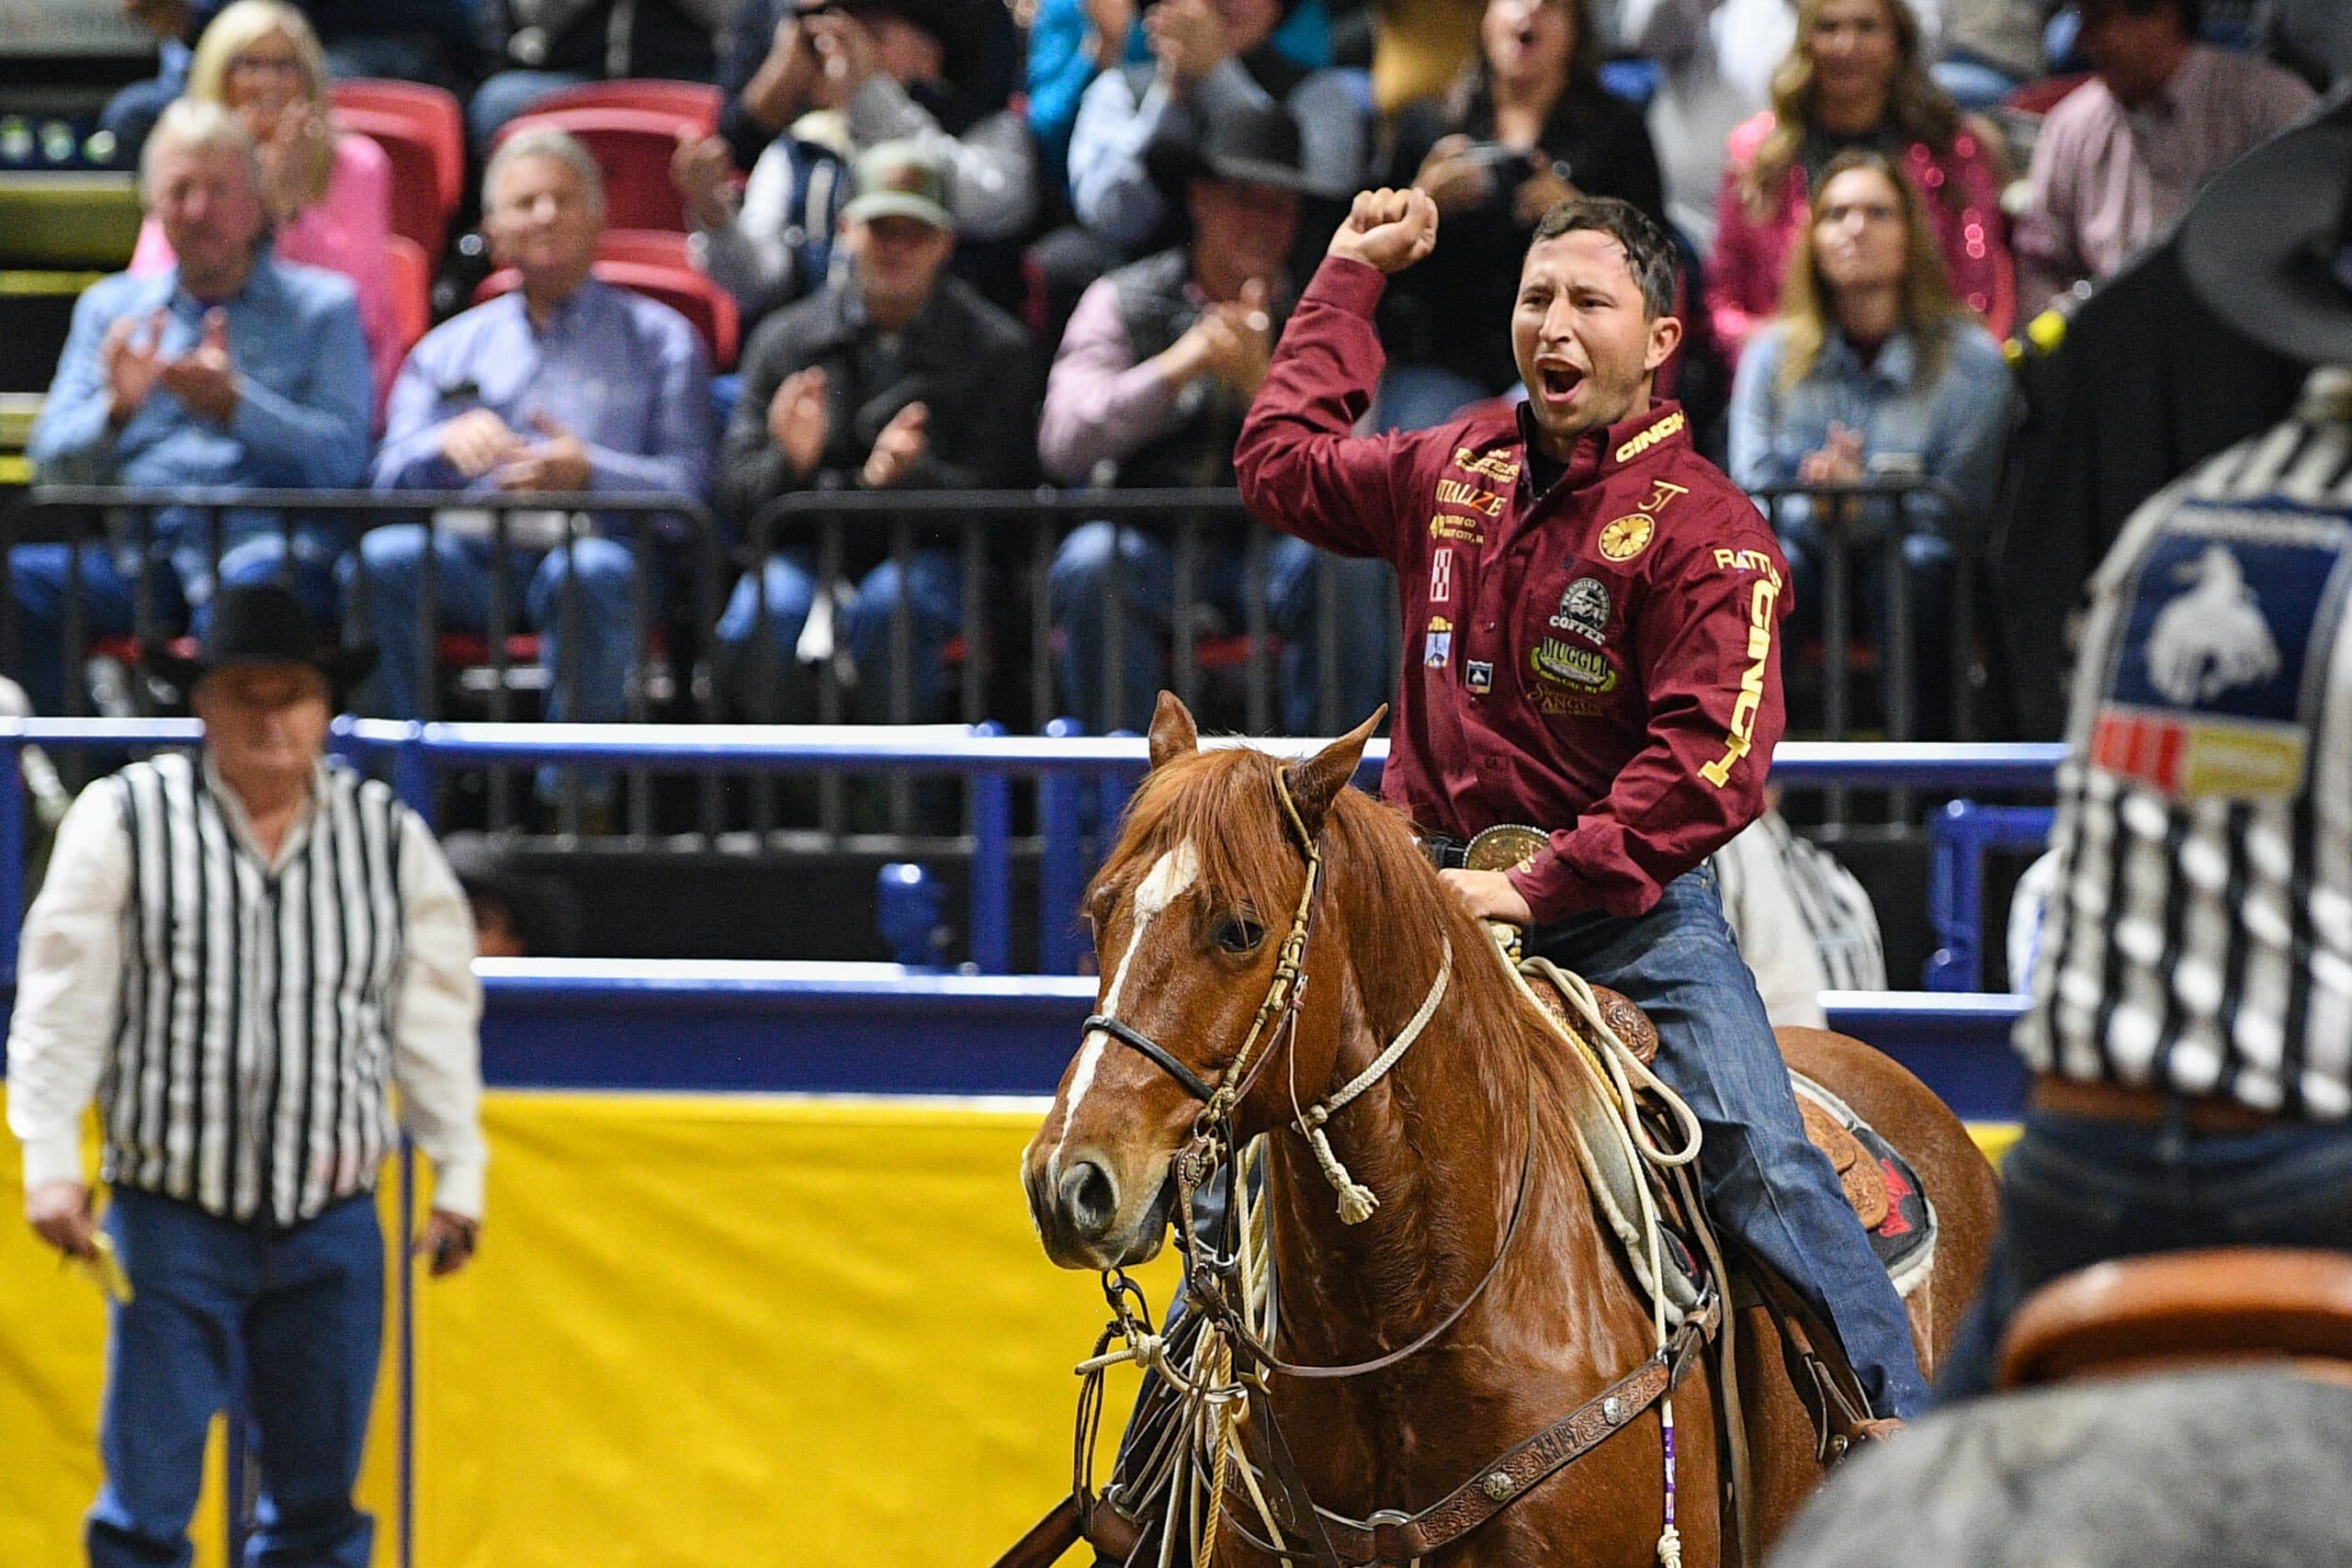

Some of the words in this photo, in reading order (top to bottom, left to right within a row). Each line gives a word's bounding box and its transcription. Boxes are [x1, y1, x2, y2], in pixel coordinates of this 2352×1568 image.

[1615, 410, 1685, 463] CINCH
[1549, 615, 1607, 646] COFFEE
[1542, 636, 1608, 677] MUGGLI
[1698, 579, 1774, 789] CINCH
